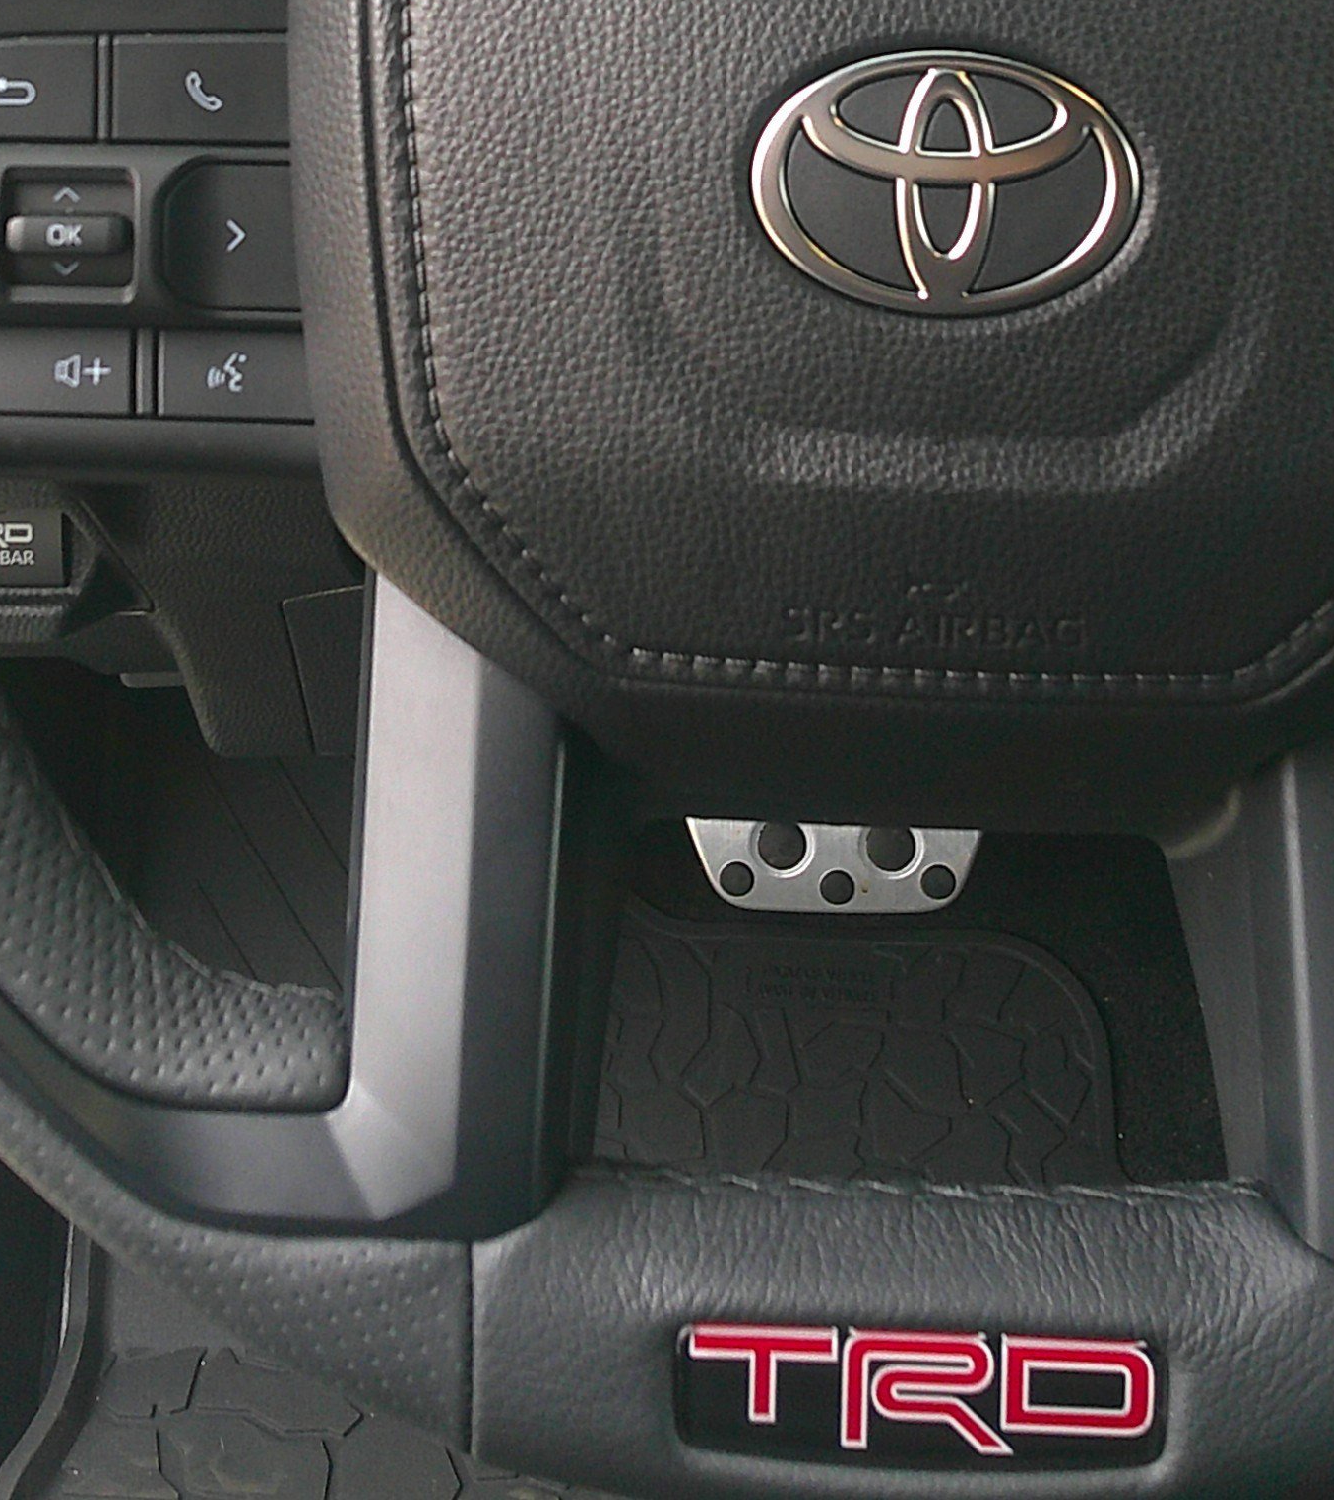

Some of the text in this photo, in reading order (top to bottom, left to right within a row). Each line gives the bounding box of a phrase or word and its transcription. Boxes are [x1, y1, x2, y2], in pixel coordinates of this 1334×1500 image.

[44, 222, 83, 247] OK
[0, 550, 35, 566] BAR
[897, 614, 1087, 651] AIRBAG
[688, 1321, 1156, 1457] TRD
